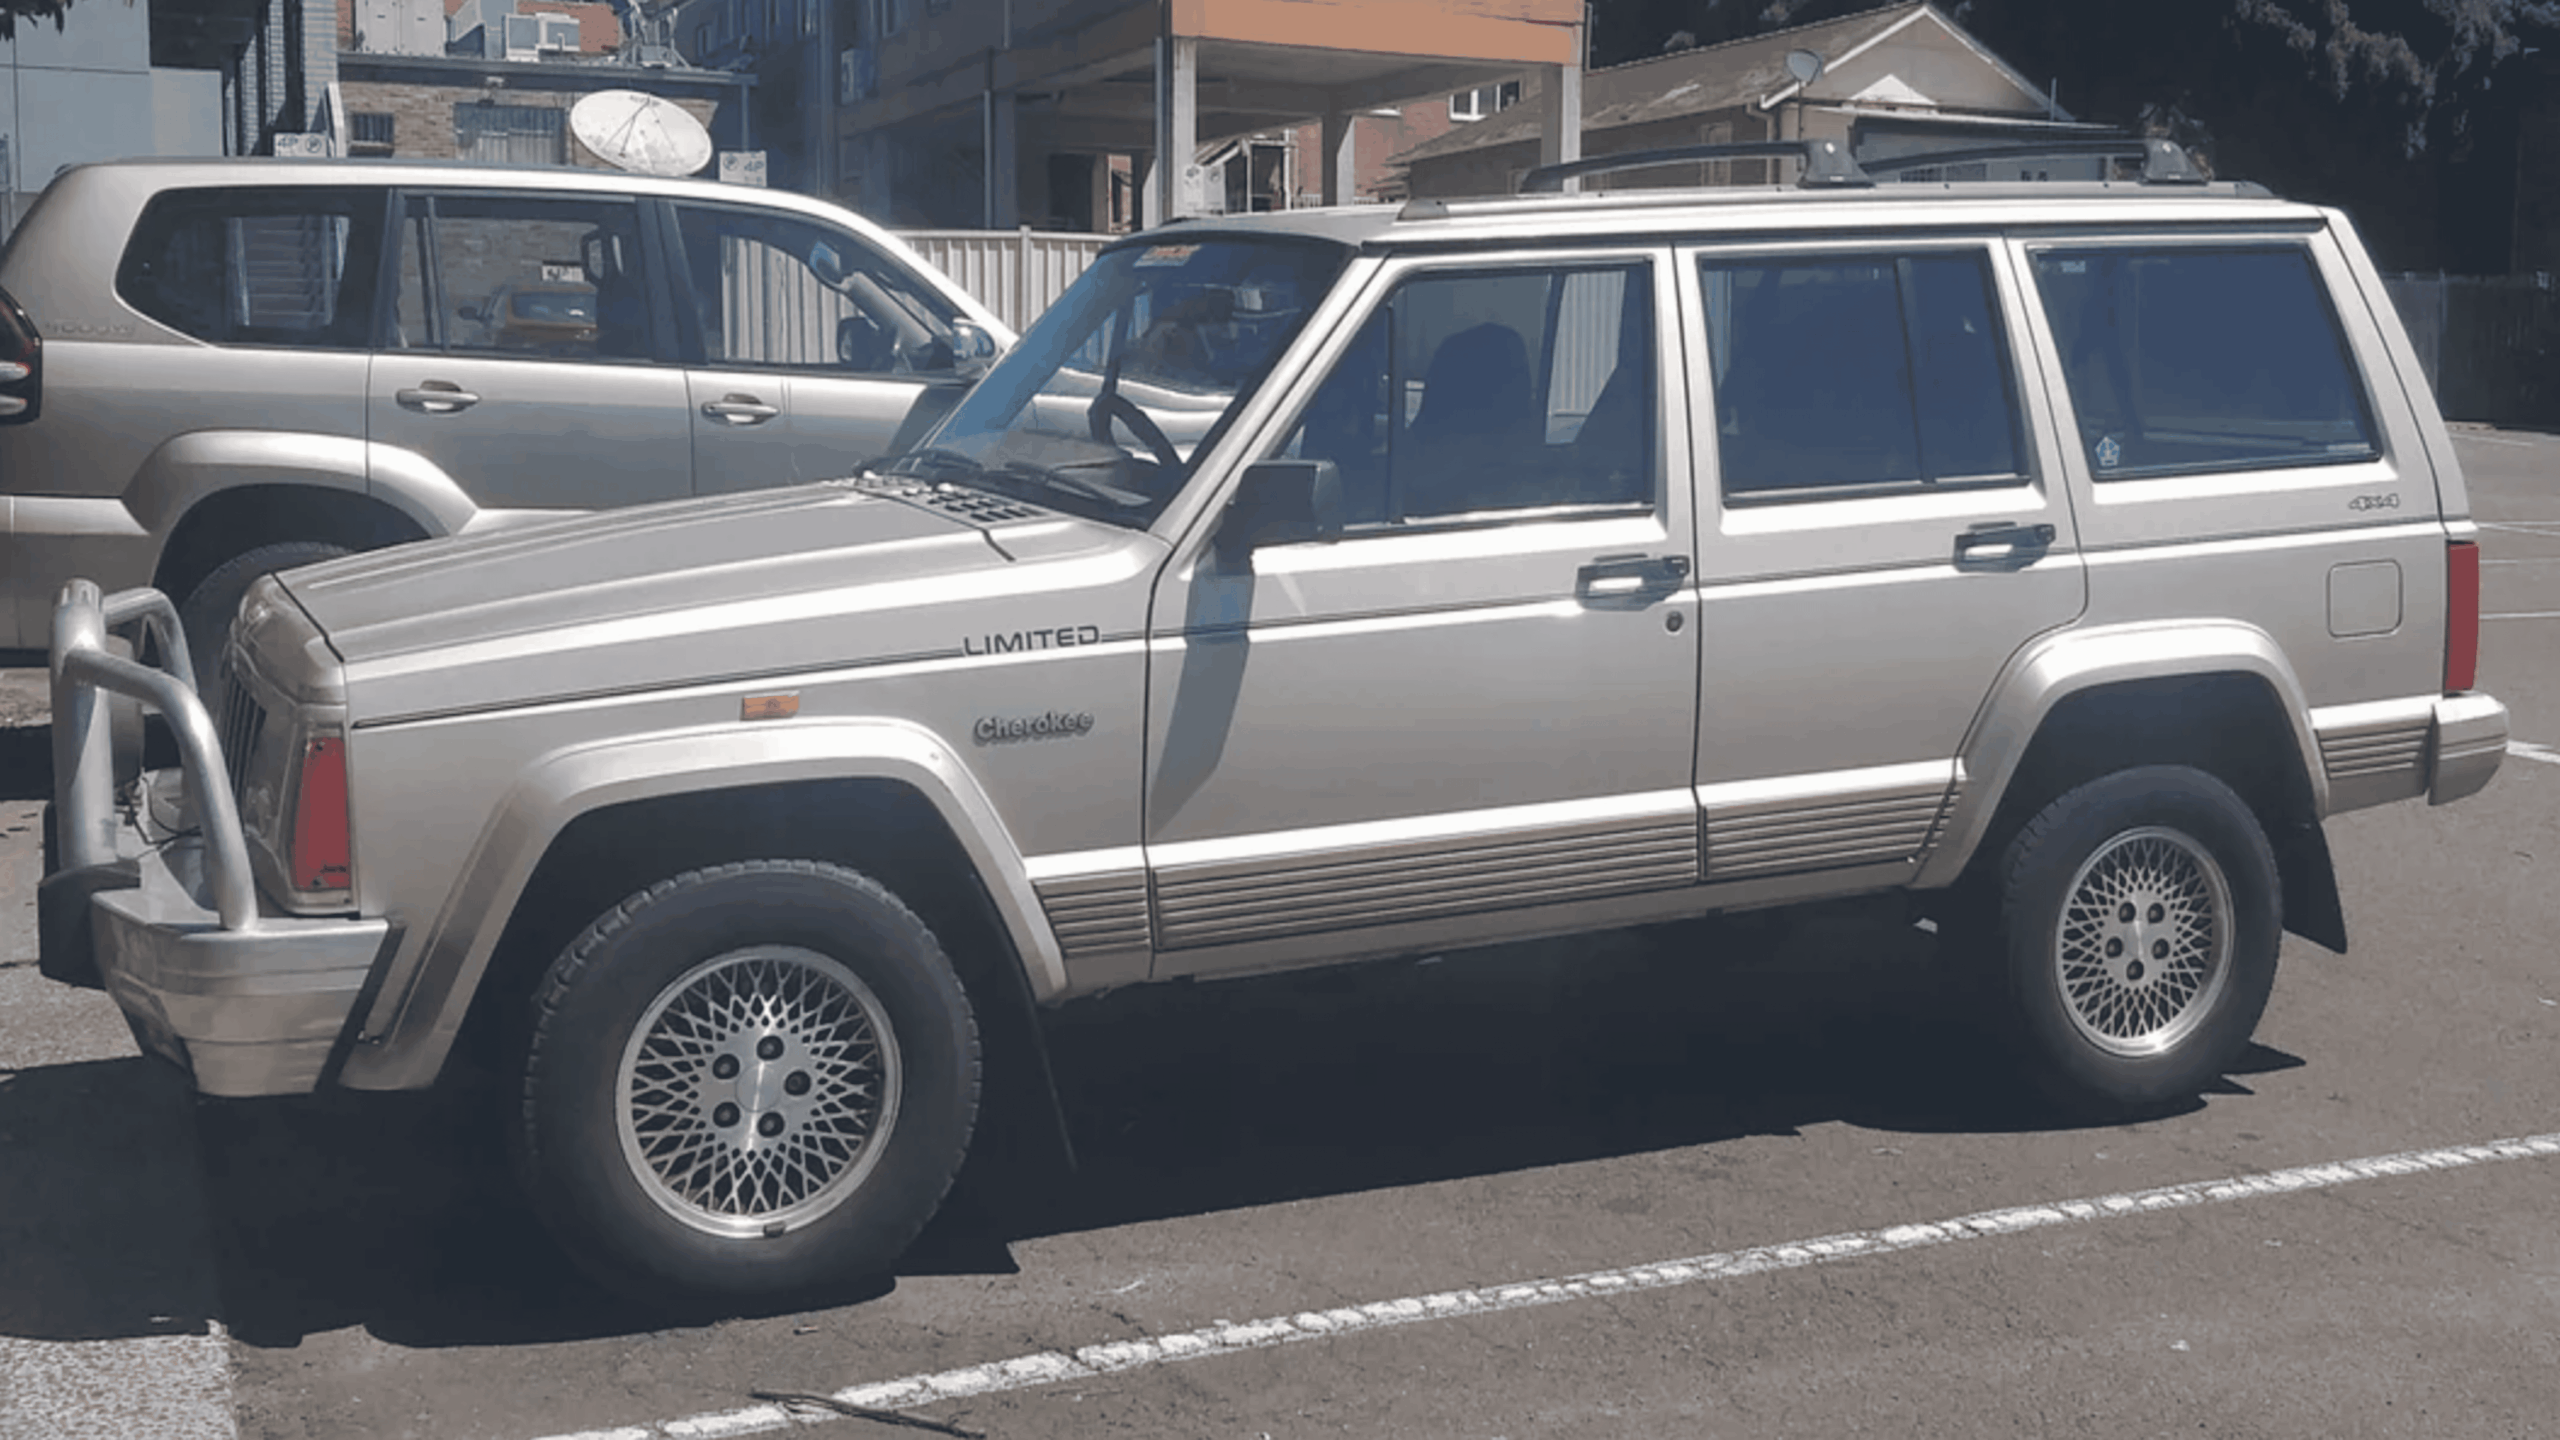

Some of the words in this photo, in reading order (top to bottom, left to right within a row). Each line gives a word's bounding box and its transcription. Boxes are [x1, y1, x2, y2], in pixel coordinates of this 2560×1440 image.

[743, 160, 765, 173] 4P
[963, 624, 1100, 656] LIMITED
[973, 710, 1094, 747] Cherokee
